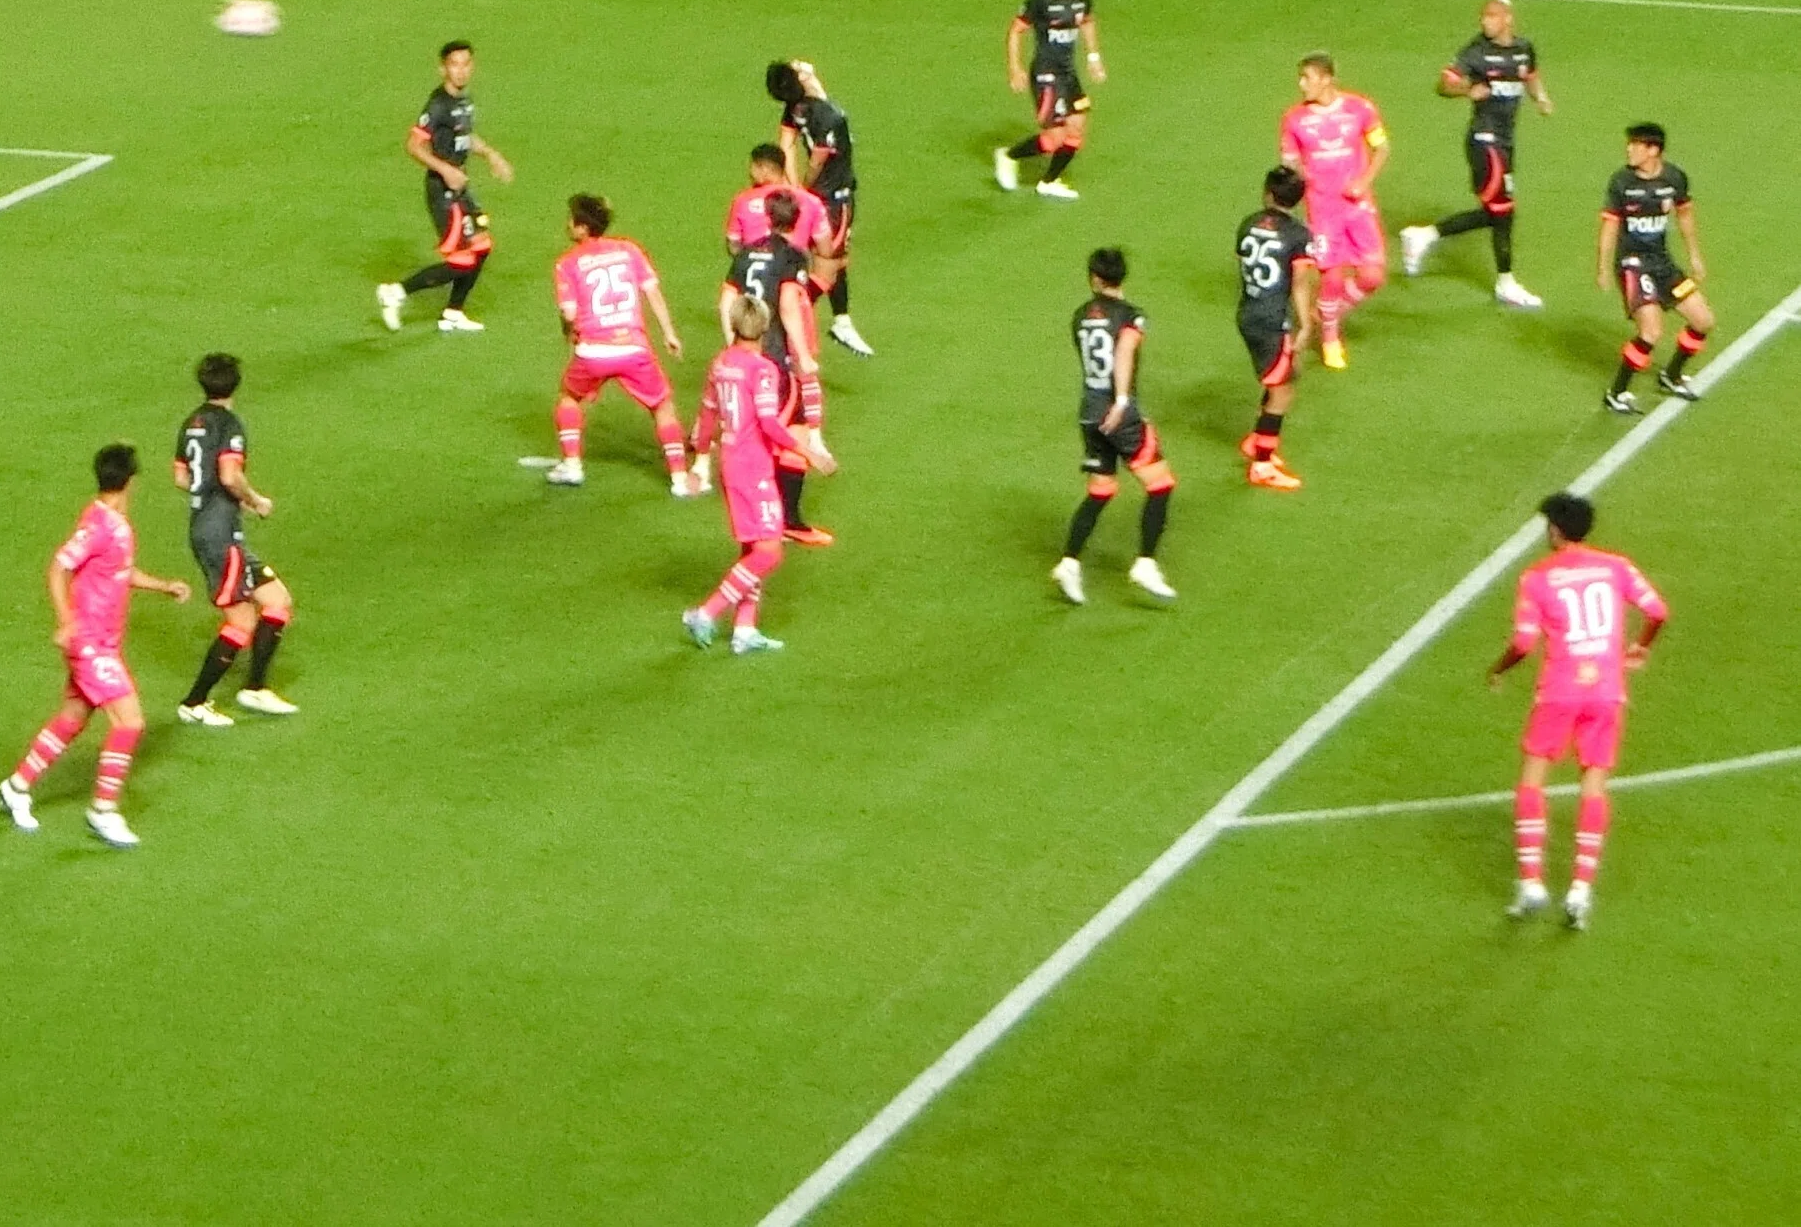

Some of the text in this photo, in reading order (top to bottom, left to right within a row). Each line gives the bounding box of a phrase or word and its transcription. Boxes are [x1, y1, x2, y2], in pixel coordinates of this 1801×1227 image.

[745, 261, 767, 301] 5
[1240, 235, 1282, 288] 25
[586, 264, 636, 316] 25
[1077, 328, 1114, 379] 13
[715, 380, 741, 431] 14
[186, 438, 203, 493] 3
[1558, 581, 1614, 642] 10
